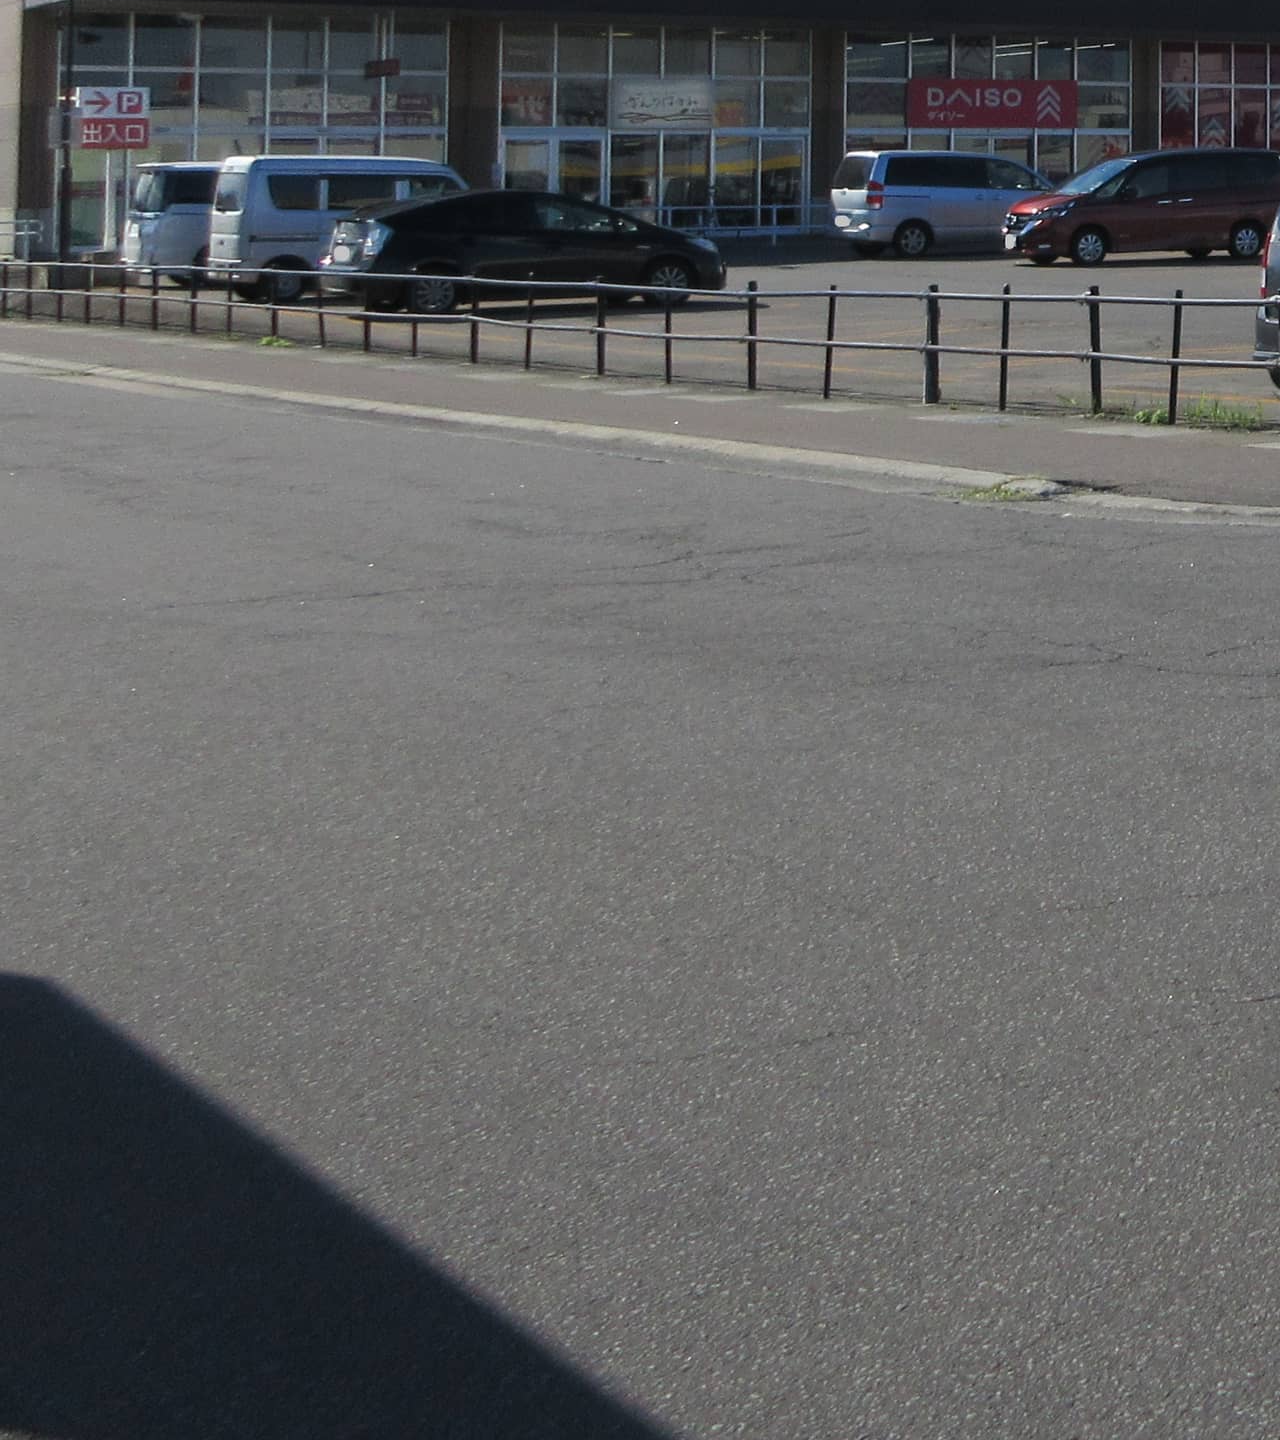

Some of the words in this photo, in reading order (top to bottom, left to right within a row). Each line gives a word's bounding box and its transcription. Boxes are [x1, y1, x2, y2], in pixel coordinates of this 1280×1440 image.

[122, 94, 139, 113] P
[927, 87, 1022, 107] DAISO
[82, 123, 145, 144] 出入口
